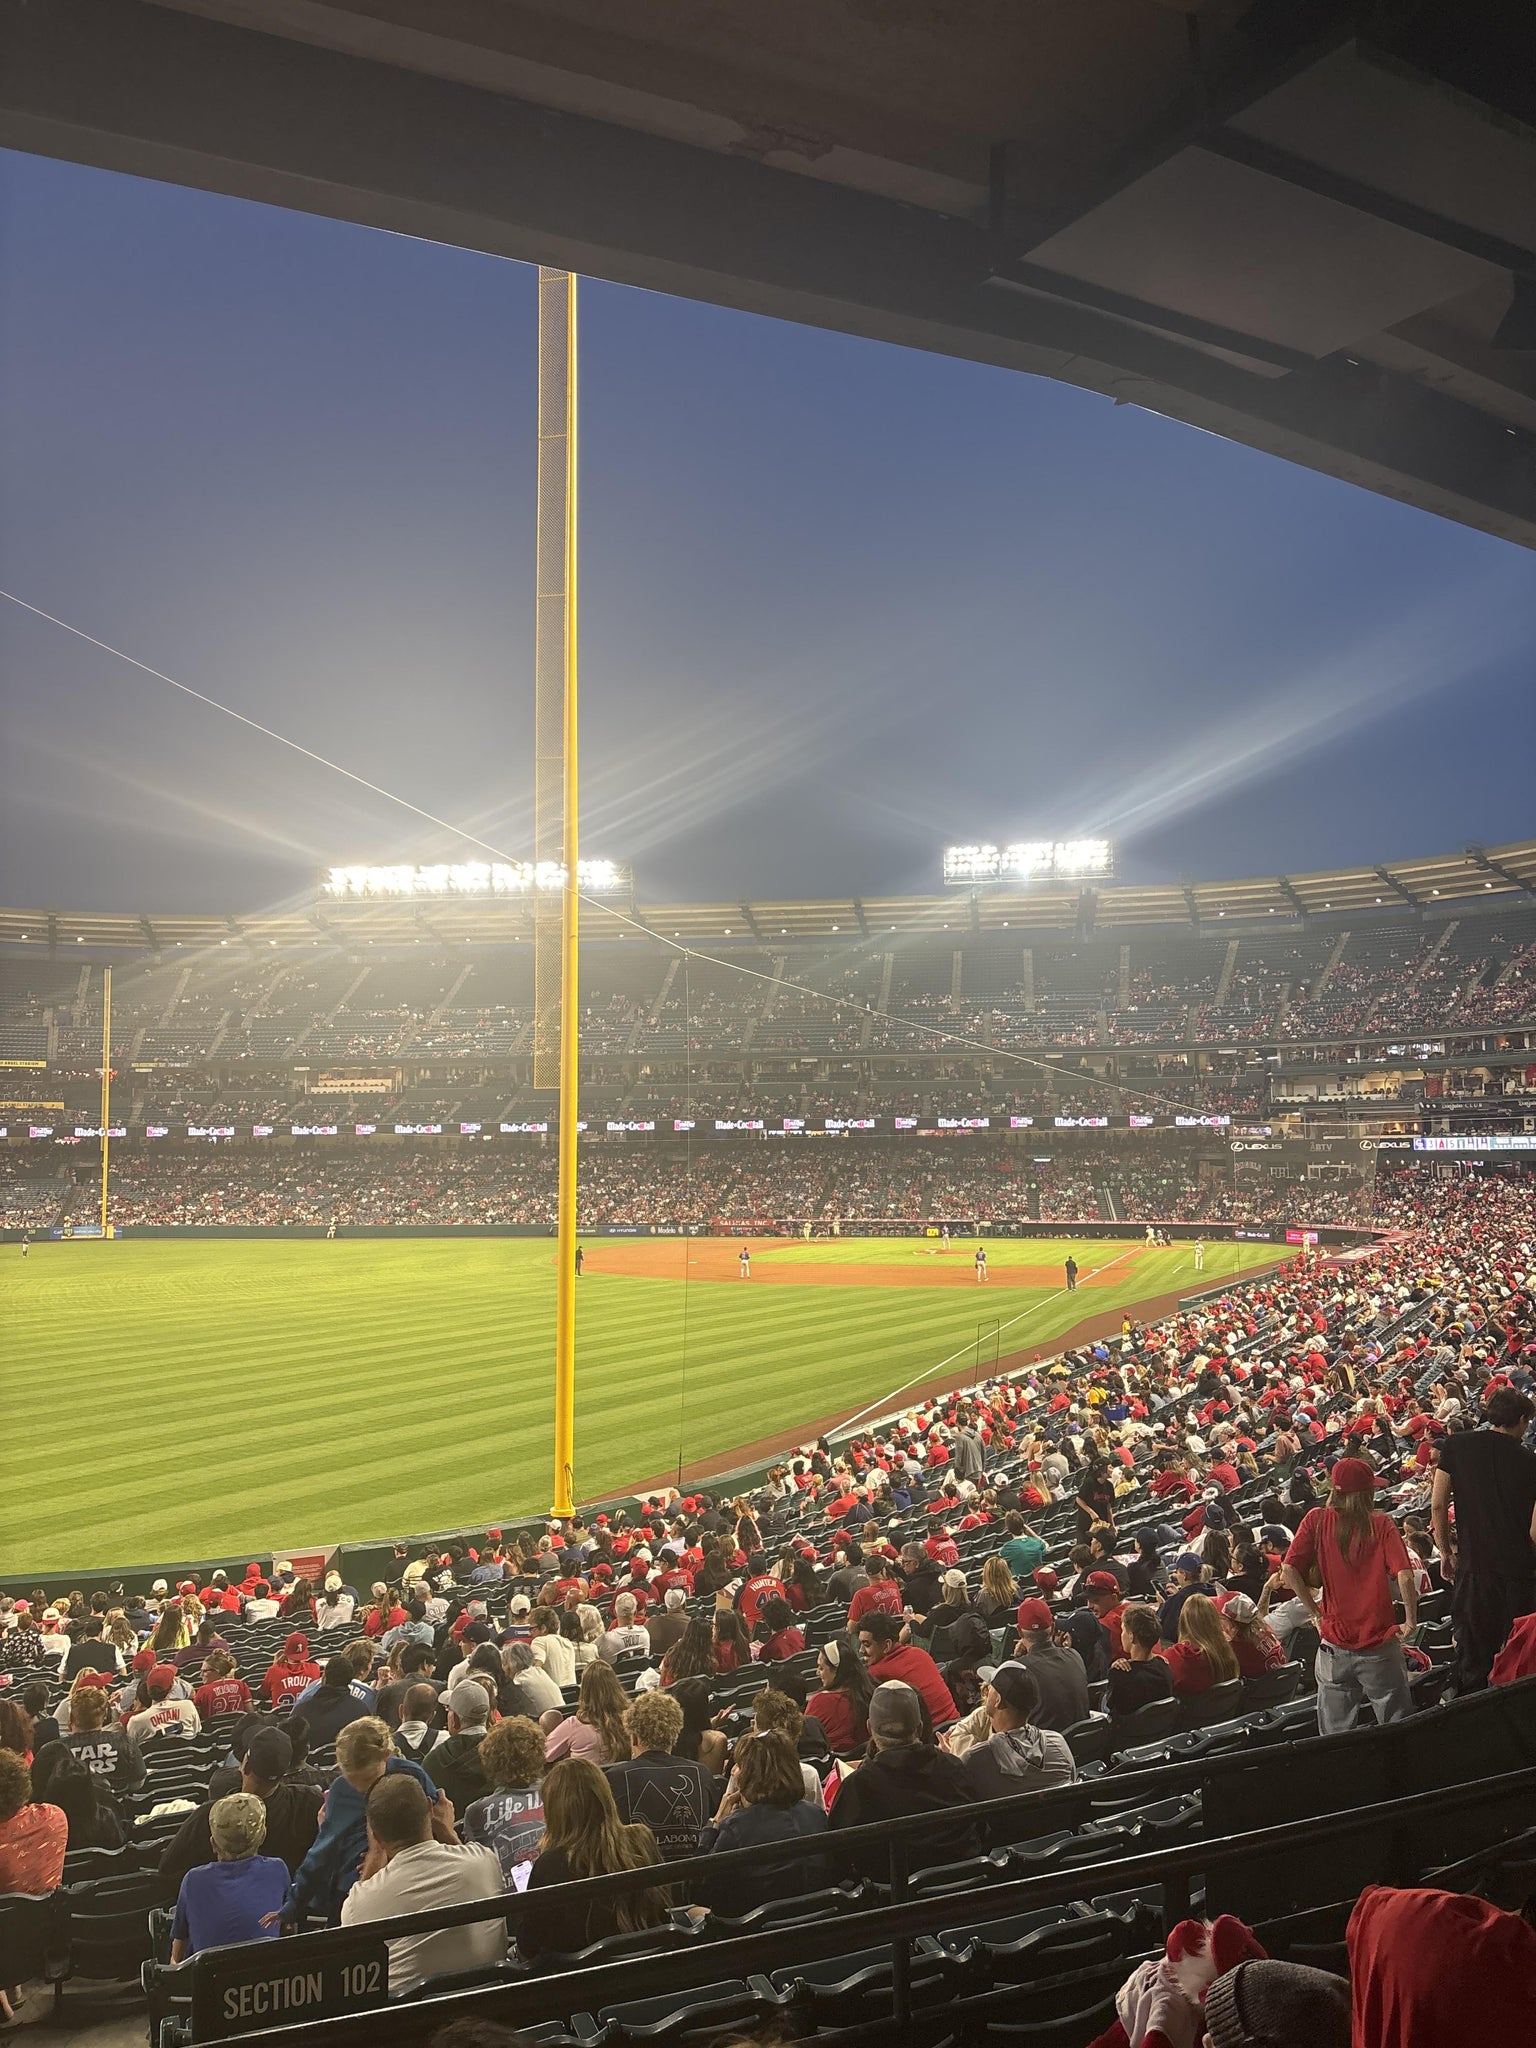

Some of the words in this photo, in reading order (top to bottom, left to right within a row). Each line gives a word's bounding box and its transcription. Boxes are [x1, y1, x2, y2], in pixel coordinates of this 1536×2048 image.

[1373, 1141, 1411, 1149] LEXUS
[750, 1578, 777, 1592] HUNTER
[213, 1684, 239, 1697] TROUT
[281, 1676, 313, 1690] TROUT
[211, 1694, 243, 1714] 27
[150, 1708, 181, 1728] OHTANI
[483, 1797, 525, 1831] Life
[223, 1971, 323, 2020] SECTION
[340, 1961, 381, 1998] 102
